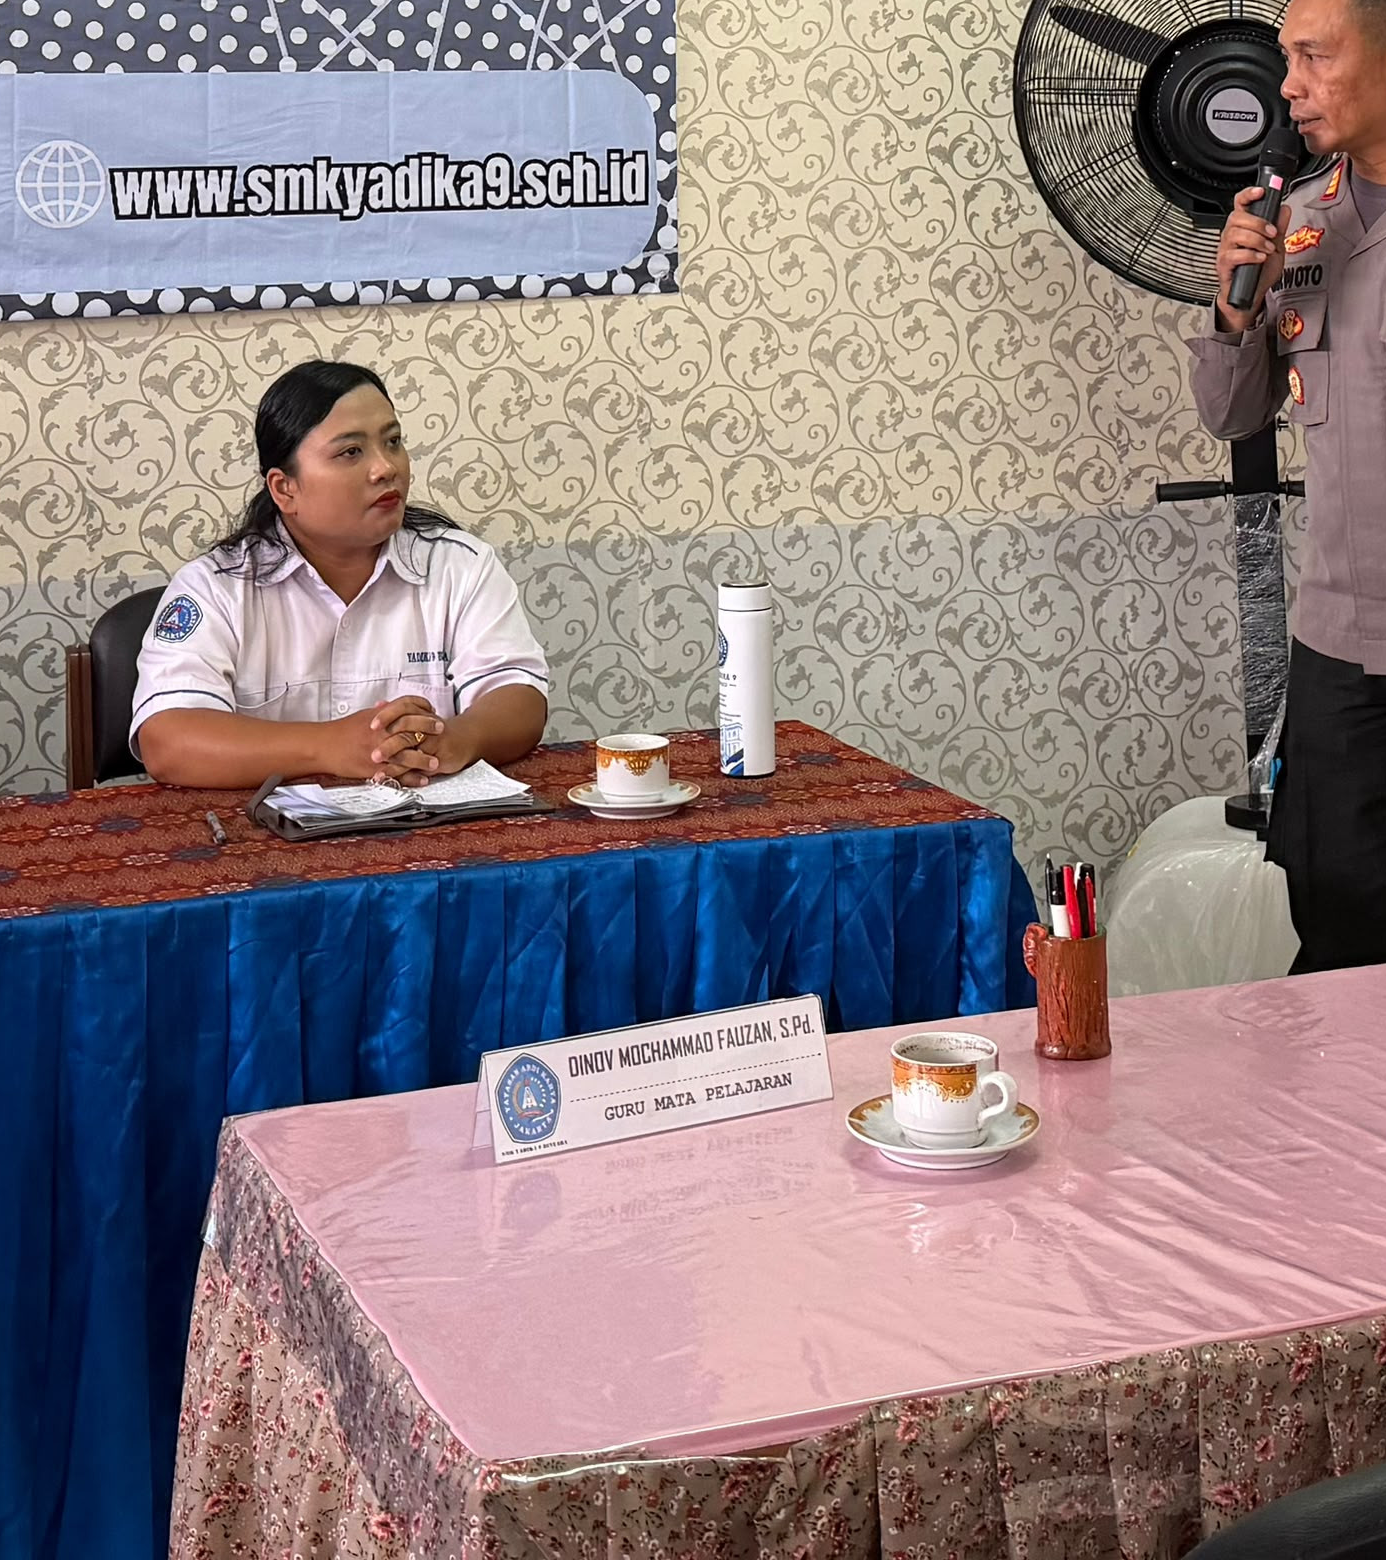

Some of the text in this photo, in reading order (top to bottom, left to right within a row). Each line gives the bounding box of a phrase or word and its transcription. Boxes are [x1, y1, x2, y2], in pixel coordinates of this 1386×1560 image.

[108, 150, 650, 221] www.smkyadika9.sch.id
[568, 1014, 815, 1078] DINOV MOCHAMMAD FAUZAN, S.Pd.
[604, 1073, 793, 1121] GURU MATA PELAJARAN
